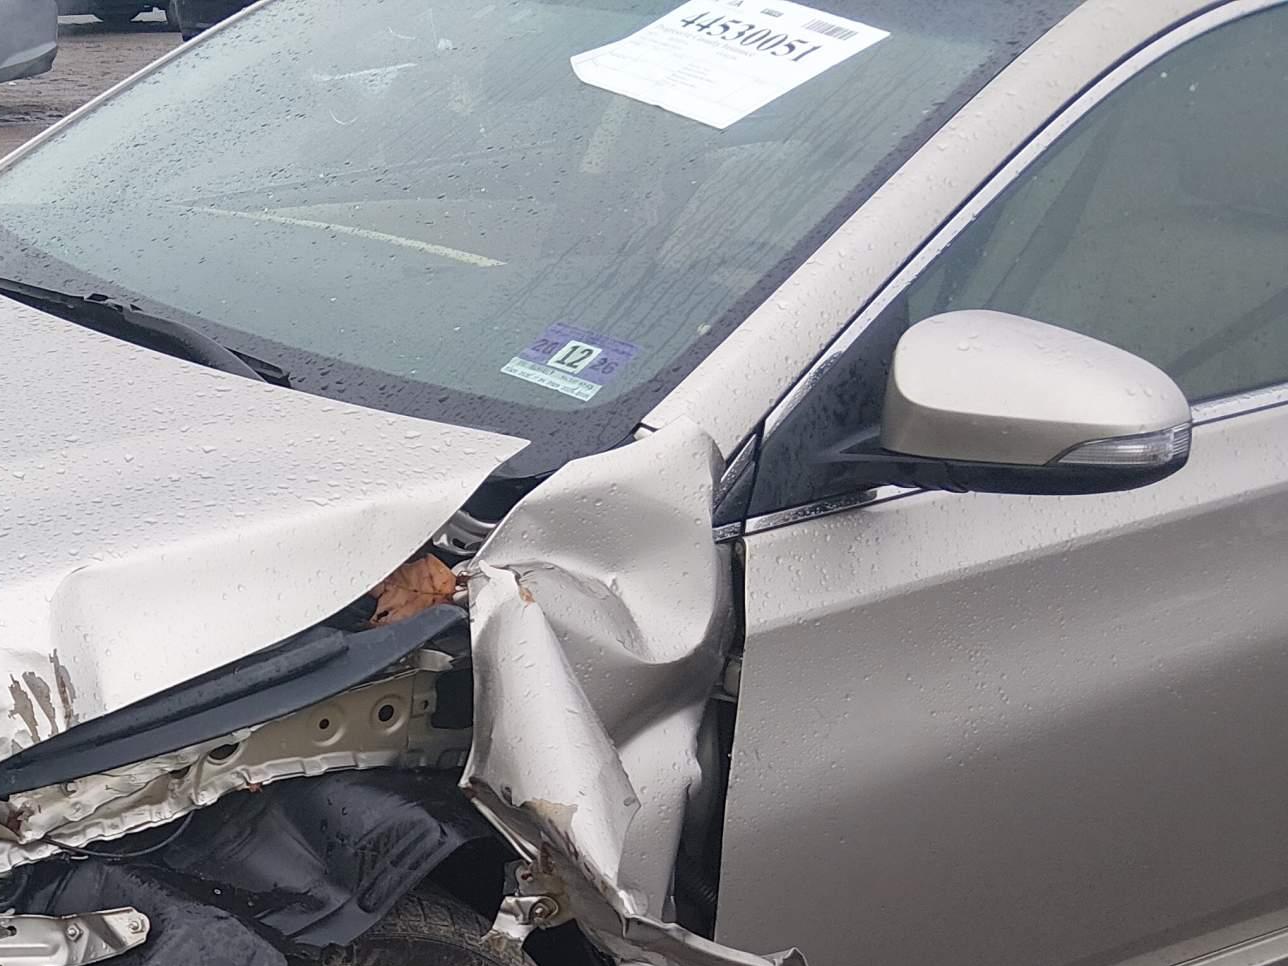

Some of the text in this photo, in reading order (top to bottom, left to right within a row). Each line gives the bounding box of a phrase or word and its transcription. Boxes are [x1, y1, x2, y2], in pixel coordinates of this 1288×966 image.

[680, 11, 825, 62] 44530051
[532, 338, 559, 355] 20
[554, 345, 594, 370] 12
[588, 357, 620, 375] 26
